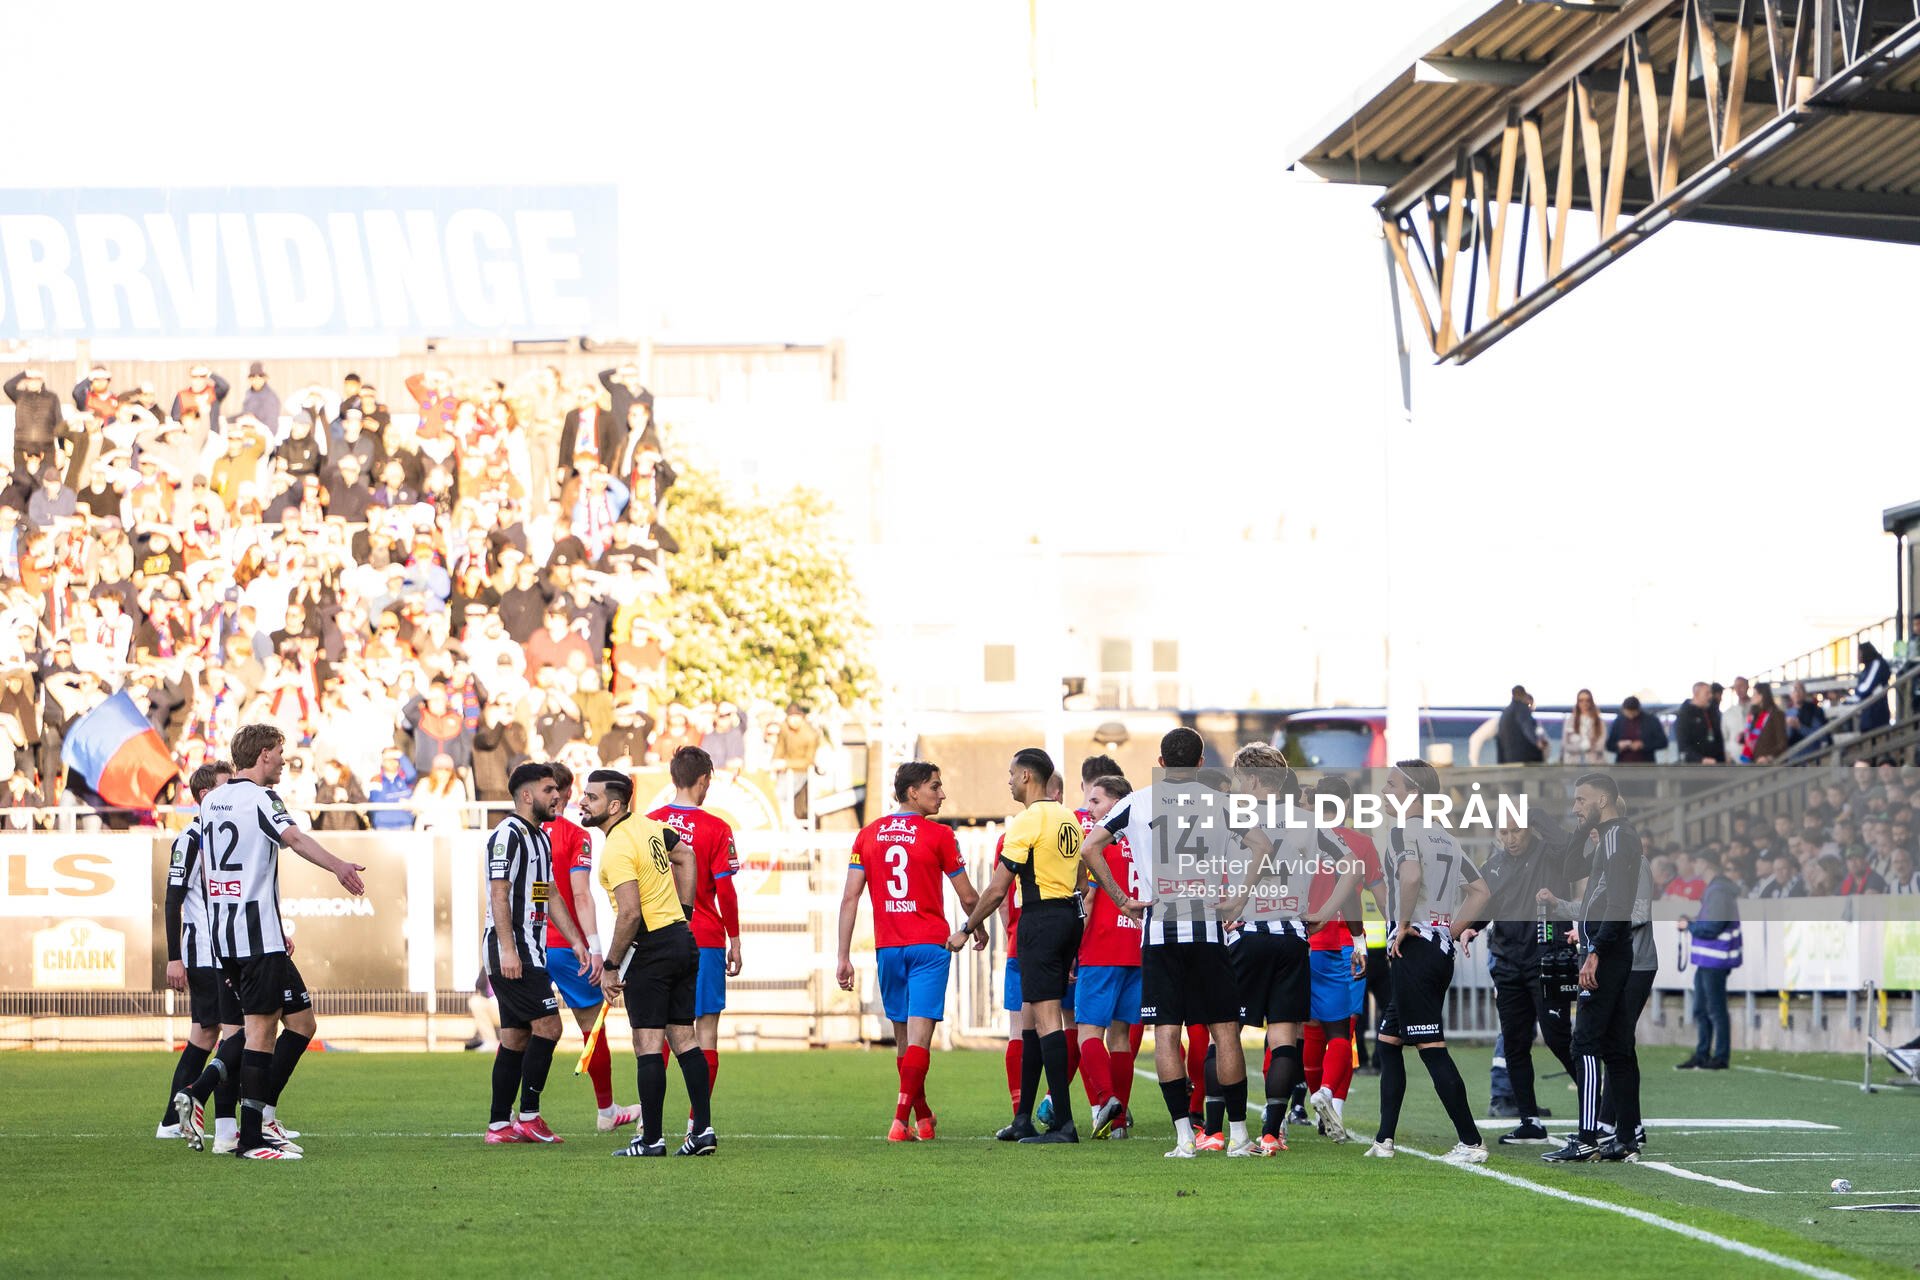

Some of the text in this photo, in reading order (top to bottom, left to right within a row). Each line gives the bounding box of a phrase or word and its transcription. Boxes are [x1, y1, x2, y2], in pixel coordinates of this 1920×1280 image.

[0, 208, 592, 332] RRVIDINGE
[203, 820, 243, 871] 12
[876, 833, 916, 844] letusplay
[1060, 825, 1079, 855] MG
[1148, 815, 1209, 864] 14
[885, 845, 909, 899] 3
[1436, 853, 1454, 902] 7
[210, 881, 241, 896] PULS
[885, 900, 917, 913] NILSSON
[1257, 899, 1298, 911] PULS
[43, 949, 117, 970] CHARK
[1407, 1023, 1440, 1032] FLYTGOLV
